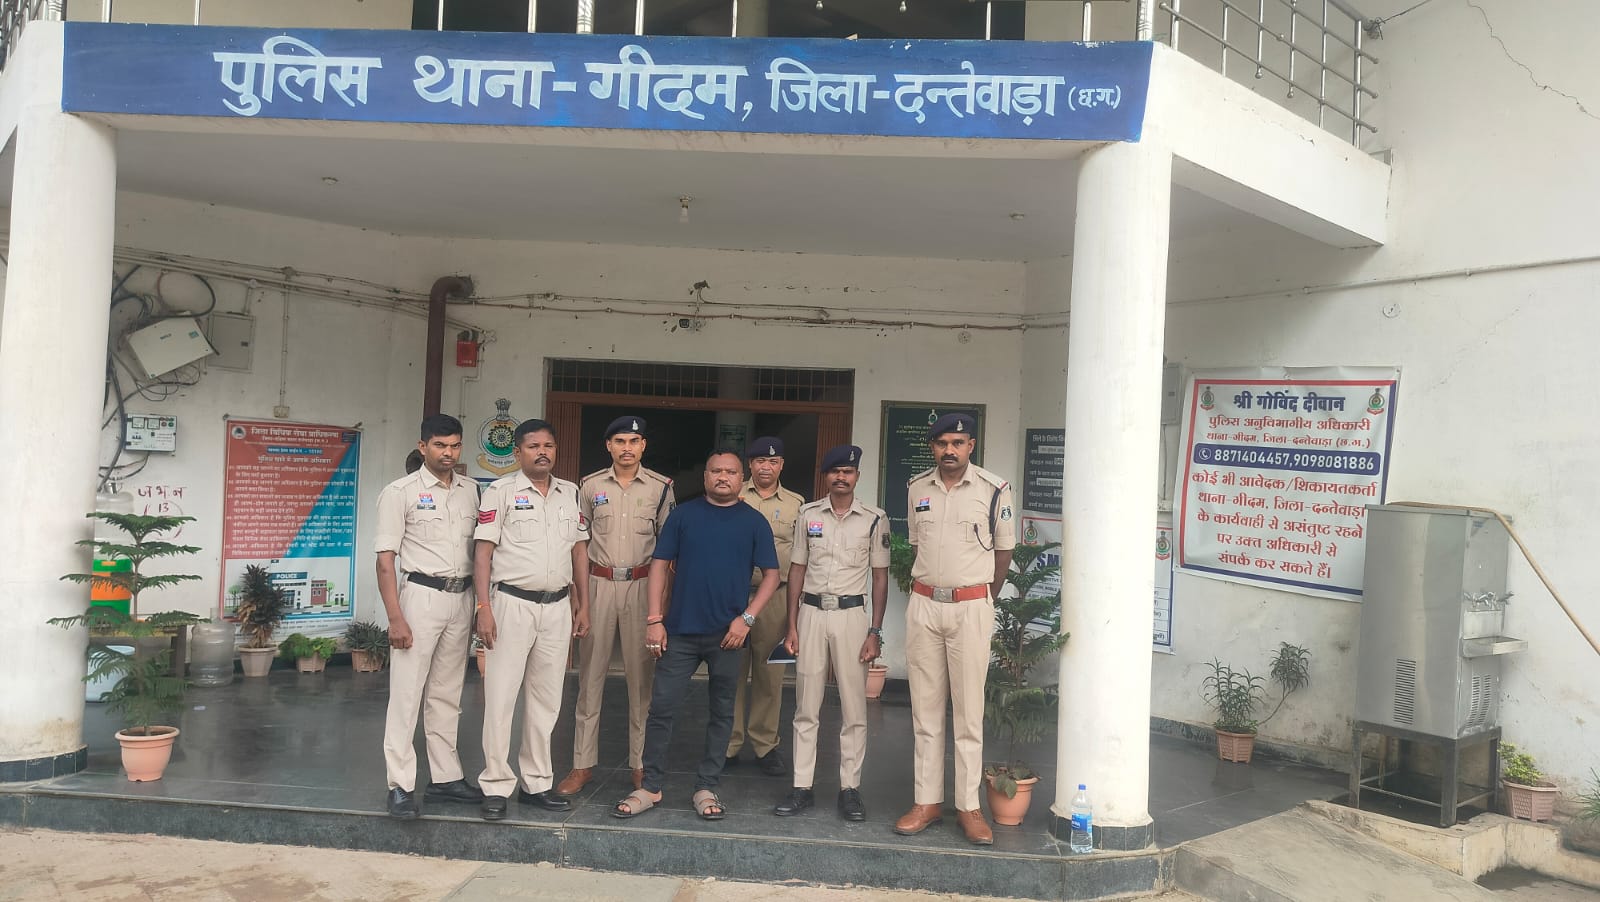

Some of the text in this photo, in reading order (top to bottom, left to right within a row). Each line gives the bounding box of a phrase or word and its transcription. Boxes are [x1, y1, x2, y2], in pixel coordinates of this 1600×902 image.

[213, 36, 383, 116] पुलिस
[1233, 389, 1346, 413] श्री गोविंद दीवान
[1209, 414, 1371, 432] पुलिस अनुविभागीय अधिकारी
[1214, 449, 1375, 471] 8871404457,9098081886
[1191, 469, 1219, 485] कोई
[1222, 472, 1235, 486] भी
[1197, 508, 1363, 539] के कार्यवाही से असंतुष्ट रहने
[1217, 532, 1337, 557] पर उक्त अधिकारी से
[1218, 550, 1331, 579] संपर्क कर सकते हैं।
